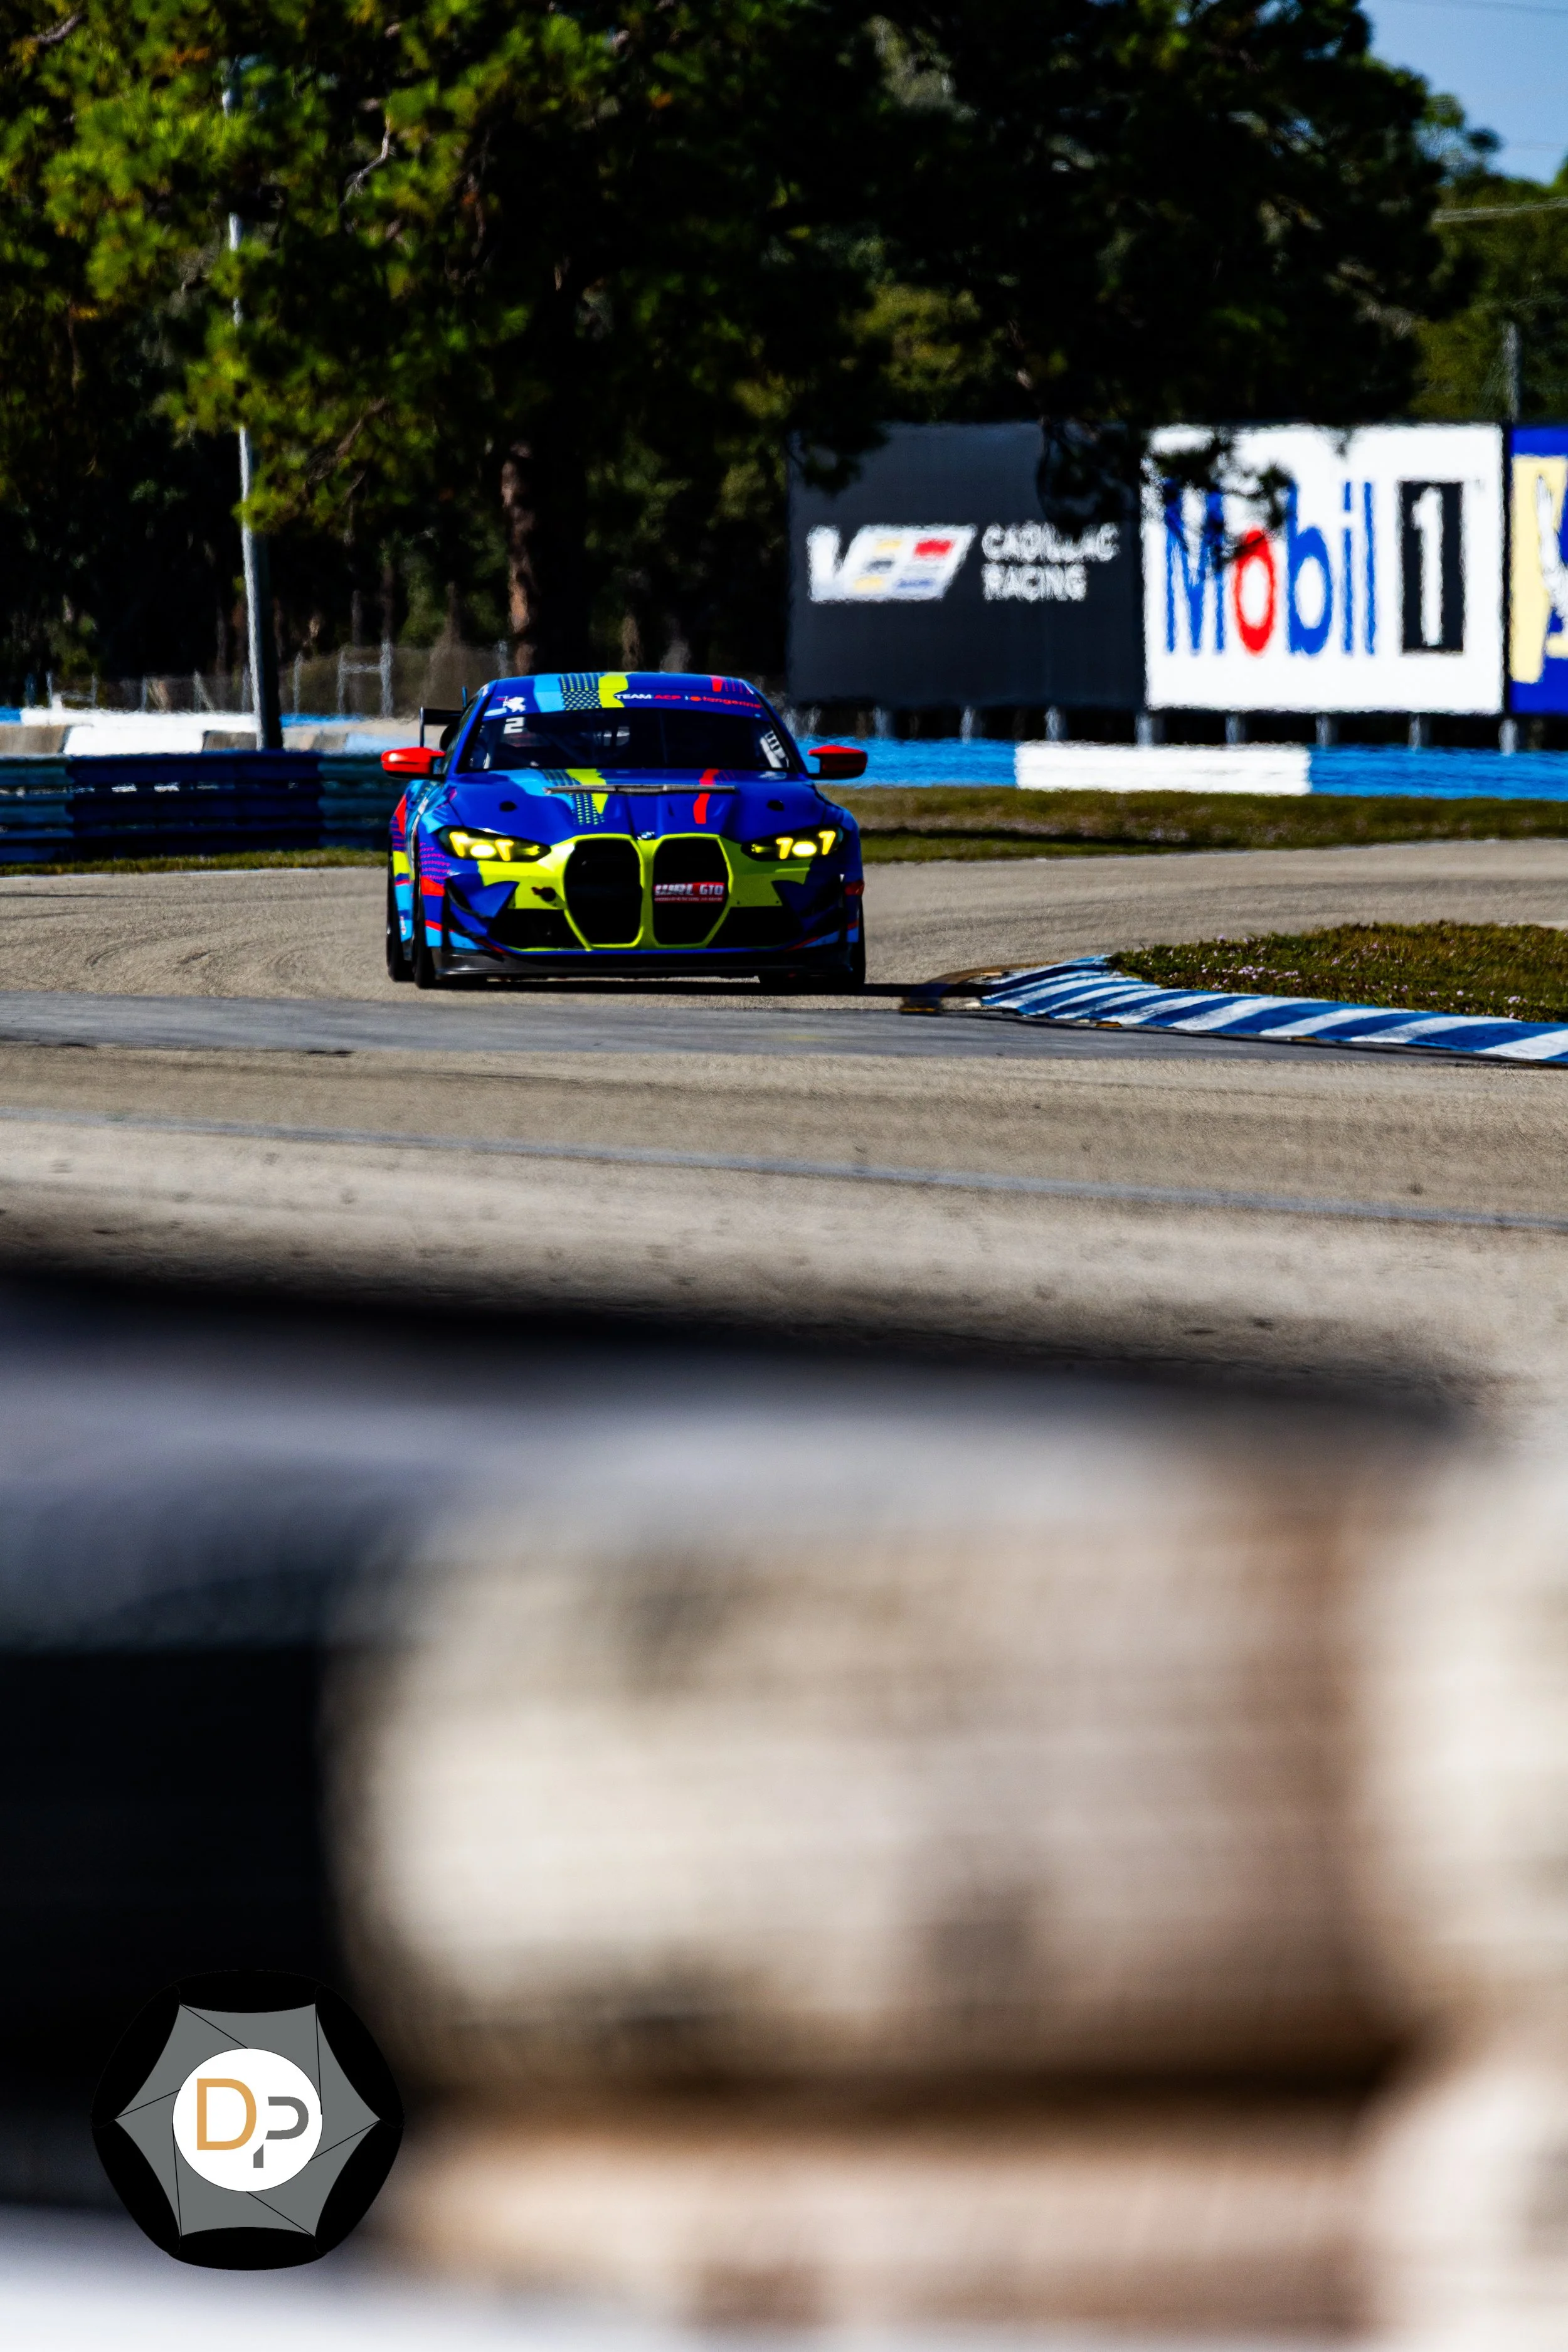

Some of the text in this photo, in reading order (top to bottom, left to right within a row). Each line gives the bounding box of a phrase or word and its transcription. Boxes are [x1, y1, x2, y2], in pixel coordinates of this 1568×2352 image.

[982, 564, 1088, 601] RACING
[1163, 479, 1376, 657] Mobil
[504, 717, 524, 734] 2
